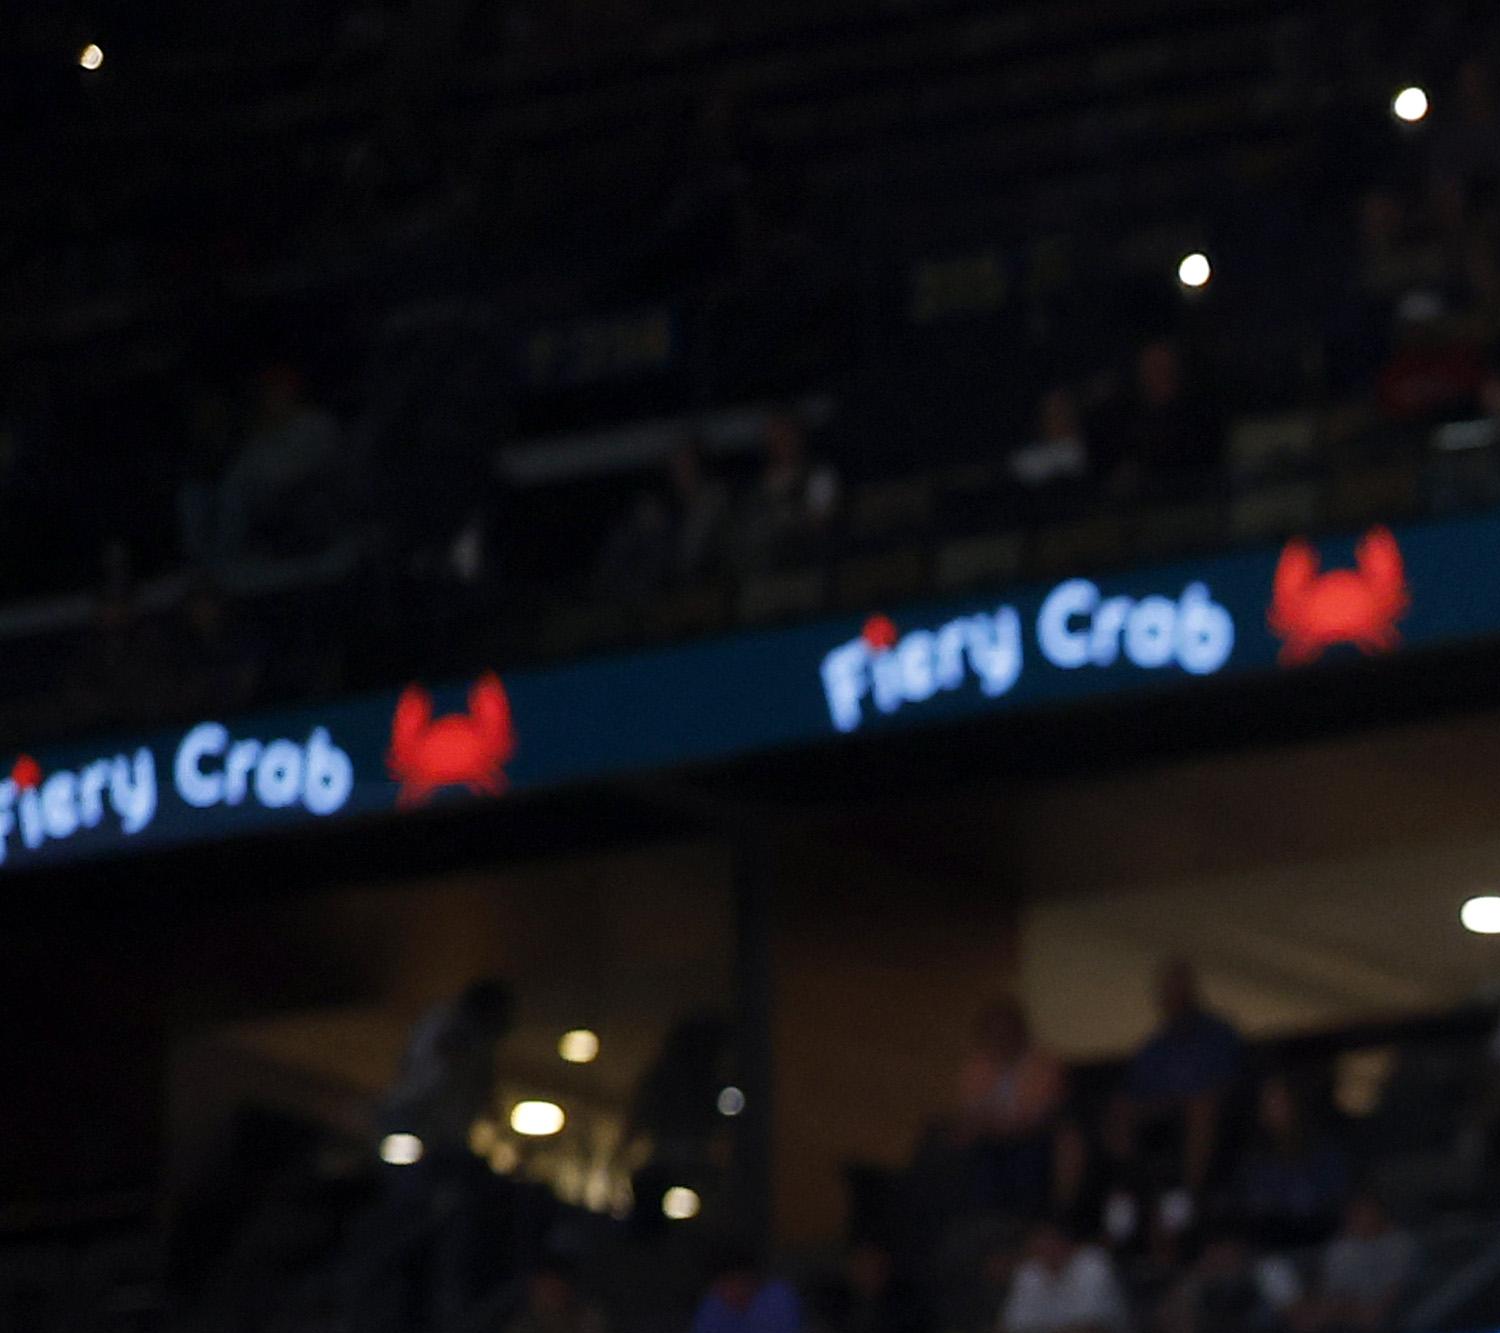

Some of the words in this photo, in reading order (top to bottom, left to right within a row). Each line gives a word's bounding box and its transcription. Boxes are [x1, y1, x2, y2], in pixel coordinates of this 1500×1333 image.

[821, 613, 1022, 732] Fiery
[1037, 577, 1234, 676] Crab
[174, 721, 354, 816] Crab
